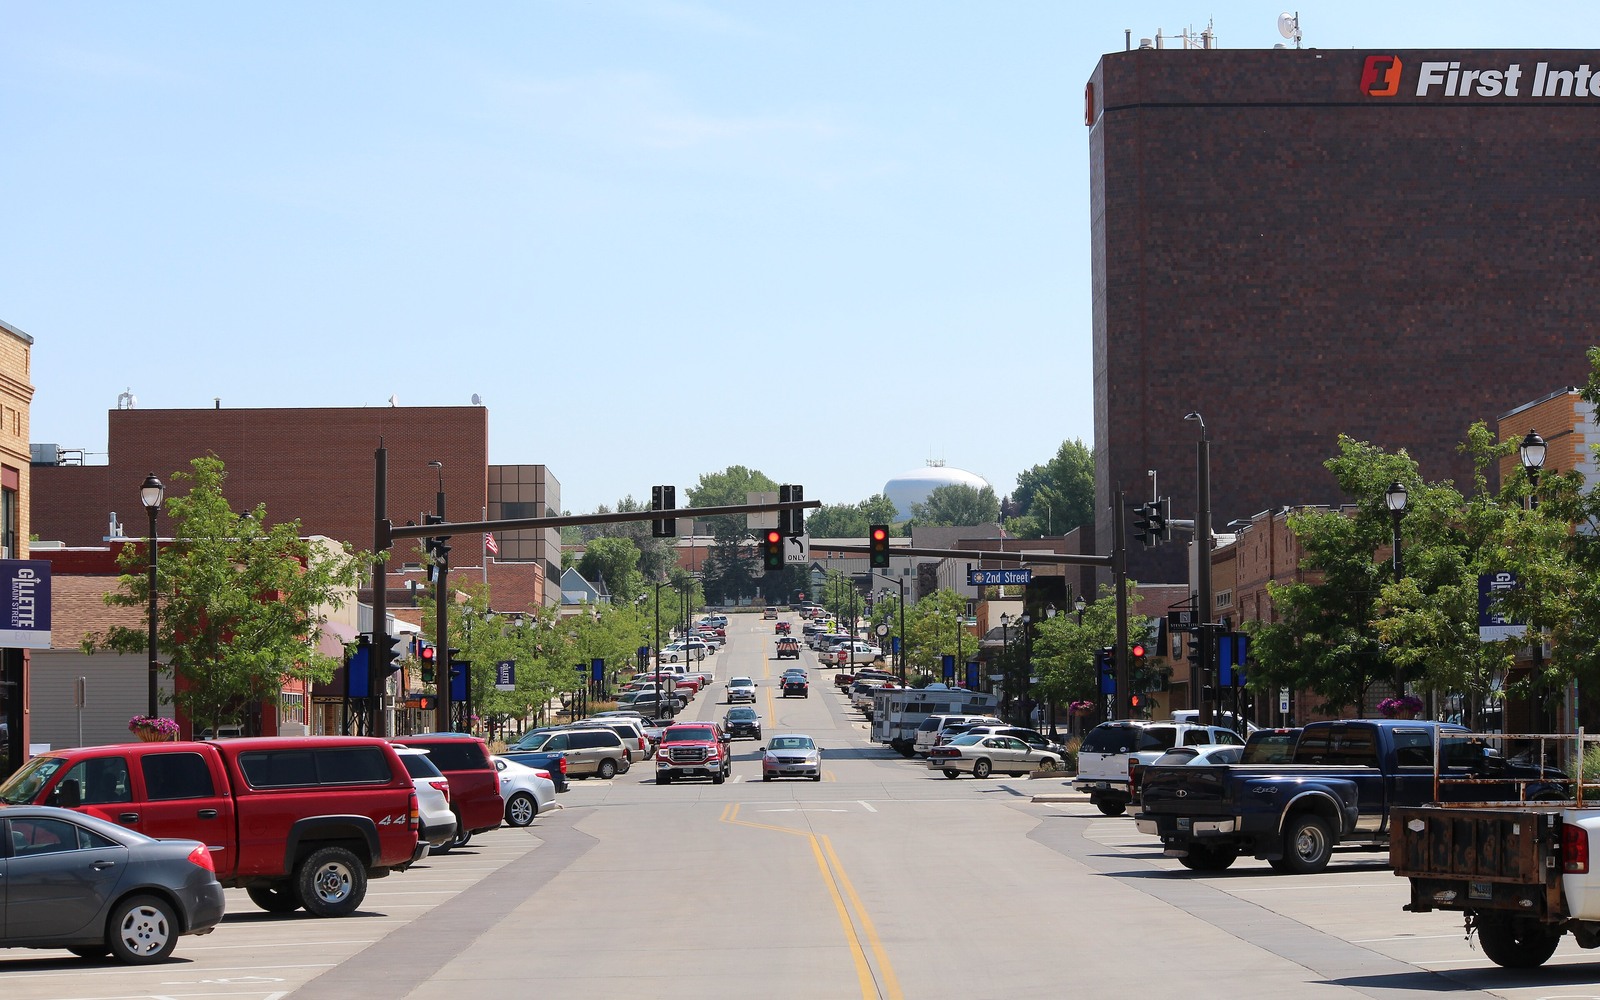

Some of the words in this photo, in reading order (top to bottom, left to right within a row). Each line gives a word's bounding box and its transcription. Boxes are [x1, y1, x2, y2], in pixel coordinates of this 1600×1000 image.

[1415, 62, 1522, 97] First
[985, 571, 1001, 583] 2nd
[1004, 571, 1029, 583] Street
[14, 568, 40, 628] GILLETTE
[15, 631, 32, 641] EAT
[1484, 627, 1521, 635] HISTORY
